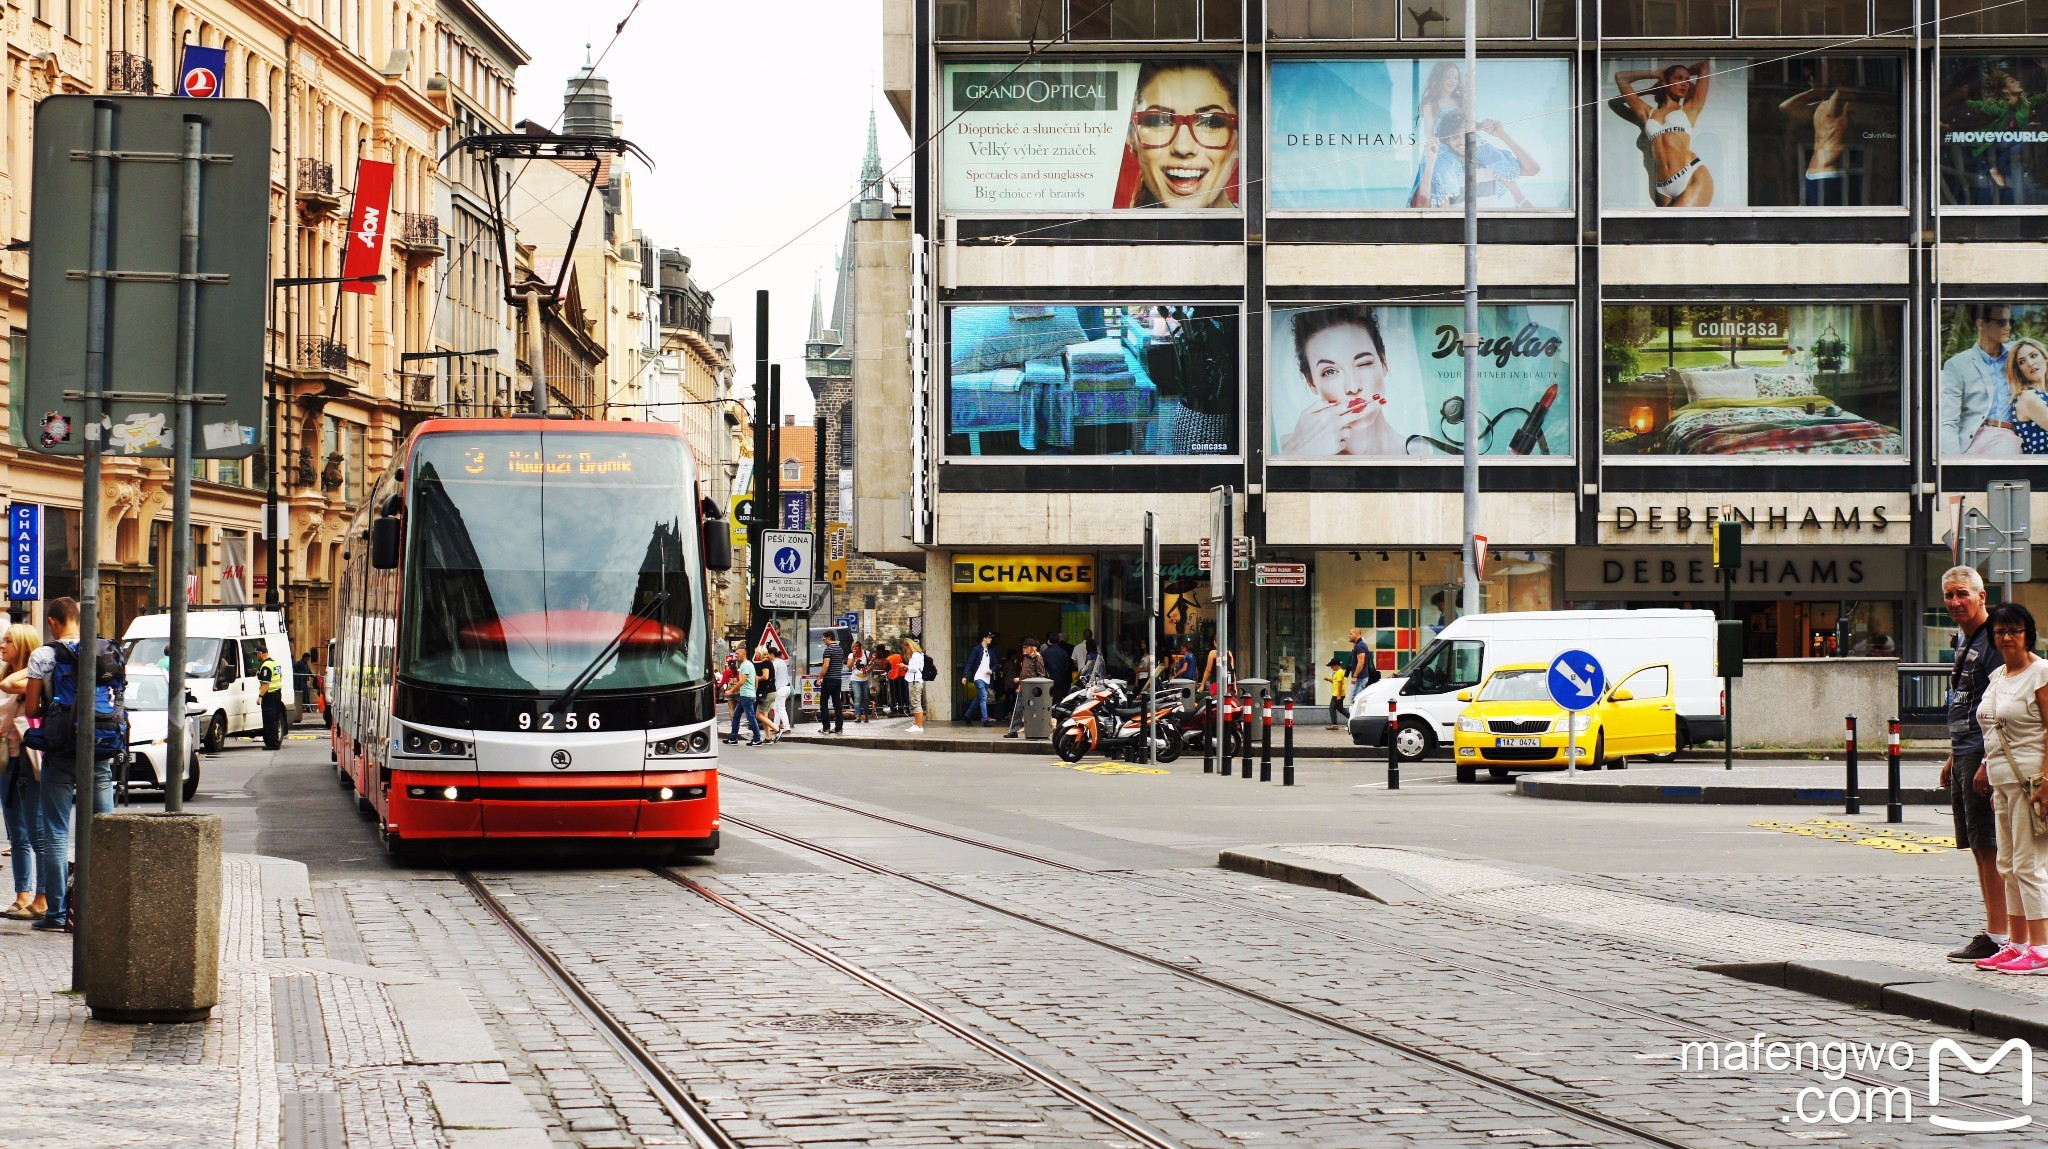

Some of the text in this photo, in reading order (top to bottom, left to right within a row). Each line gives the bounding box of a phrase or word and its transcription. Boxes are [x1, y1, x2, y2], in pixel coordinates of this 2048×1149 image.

[958, 122, 1113, 137] Dioptrické a sluneční brýle
[1862, 131, 1881, 139] Calvin
[1287, 133, 1417, 146] DEBENHAMS
[968, 141, 1096, 160] Velký výběr značek
[966, 169, 1094, 182] Spectacles and sunglasses
[974, 185, 1085, 203] Big choice of brands
[363, 206, 380, 249] AON
[1698, 320, 1778, 337] coincasa
[1431, 321, 1562, 369] Duglas
[1437, 371, 1462, 379] YOUR
[1510, 371, 1519, 379] IN
[1523, 371, 1559, 379] BEAUTY
[1191, 443, 1228, 451] coincasa
[1616, 505, 1888, 530] DEBENHAMS
[19, 508, 30, 575] CHANGE
[787, 535, 809, 544] ZÓNA
[978, 564, 1092, 583] CHANGE
[1603, 560, 1865, 584] DEBENHAMS
[12, 579, 37, 595] 0%
[518, 712, 600, 731] 9256
